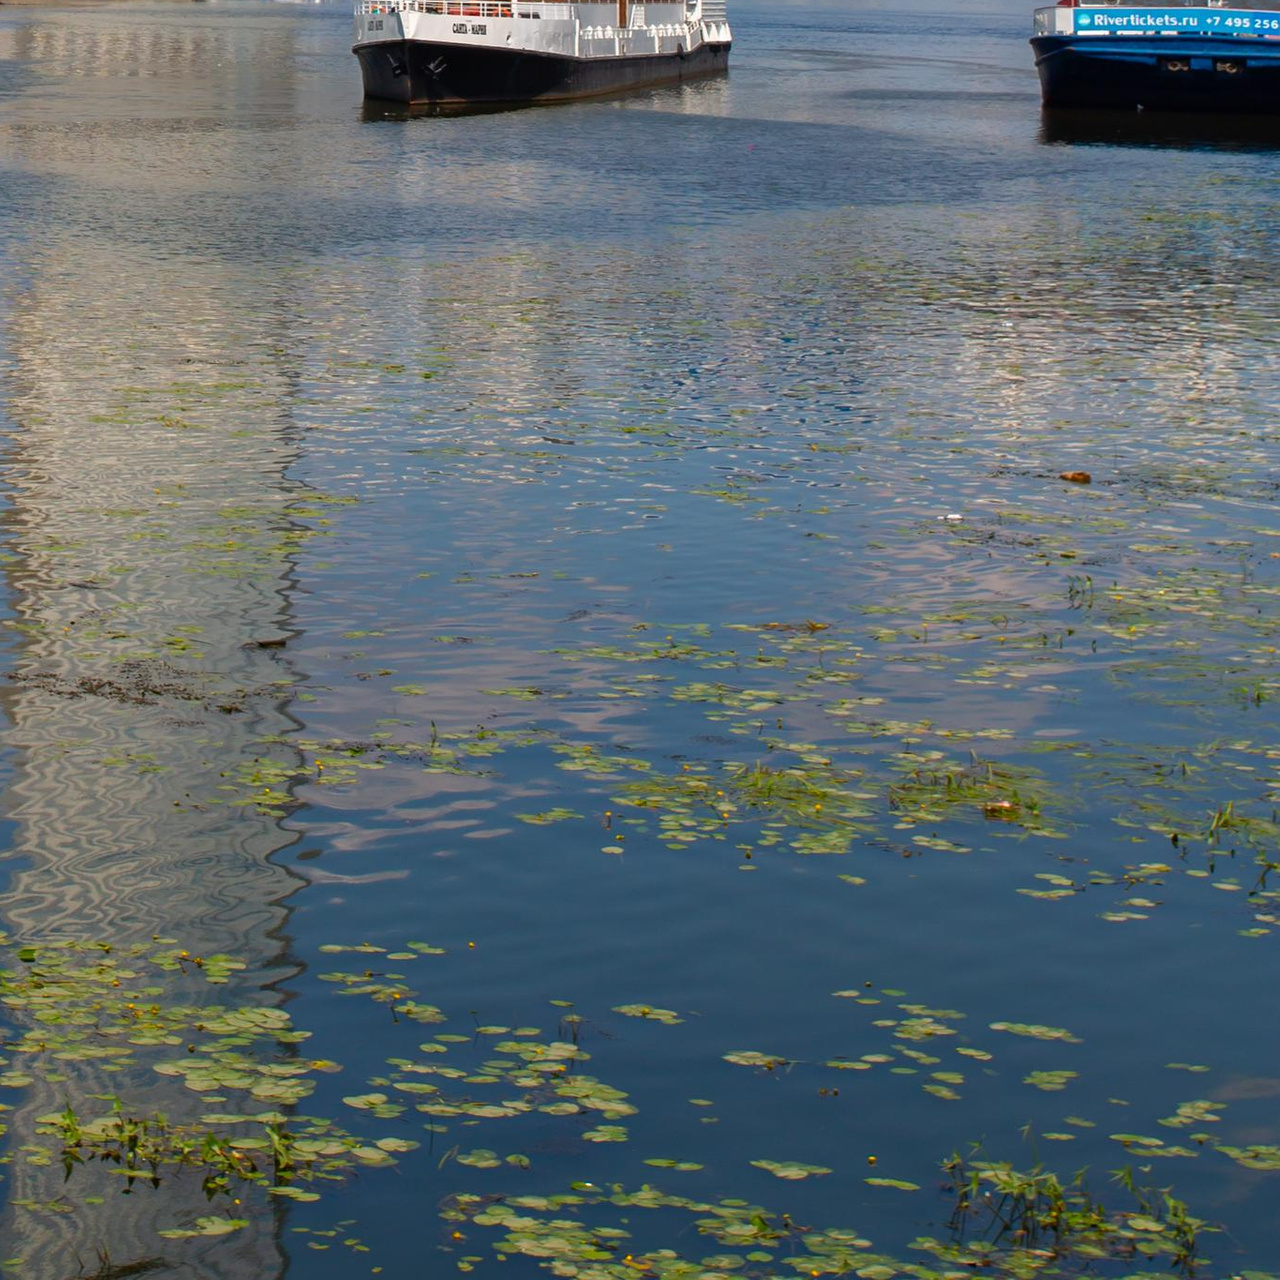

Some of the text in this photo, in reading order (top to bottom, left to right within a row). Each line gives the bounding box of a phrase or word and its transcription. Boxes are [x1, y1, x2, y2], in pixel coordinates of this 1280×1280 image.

[1093, 13, 1280, 30] Rivertickets.ru +7 495 256
